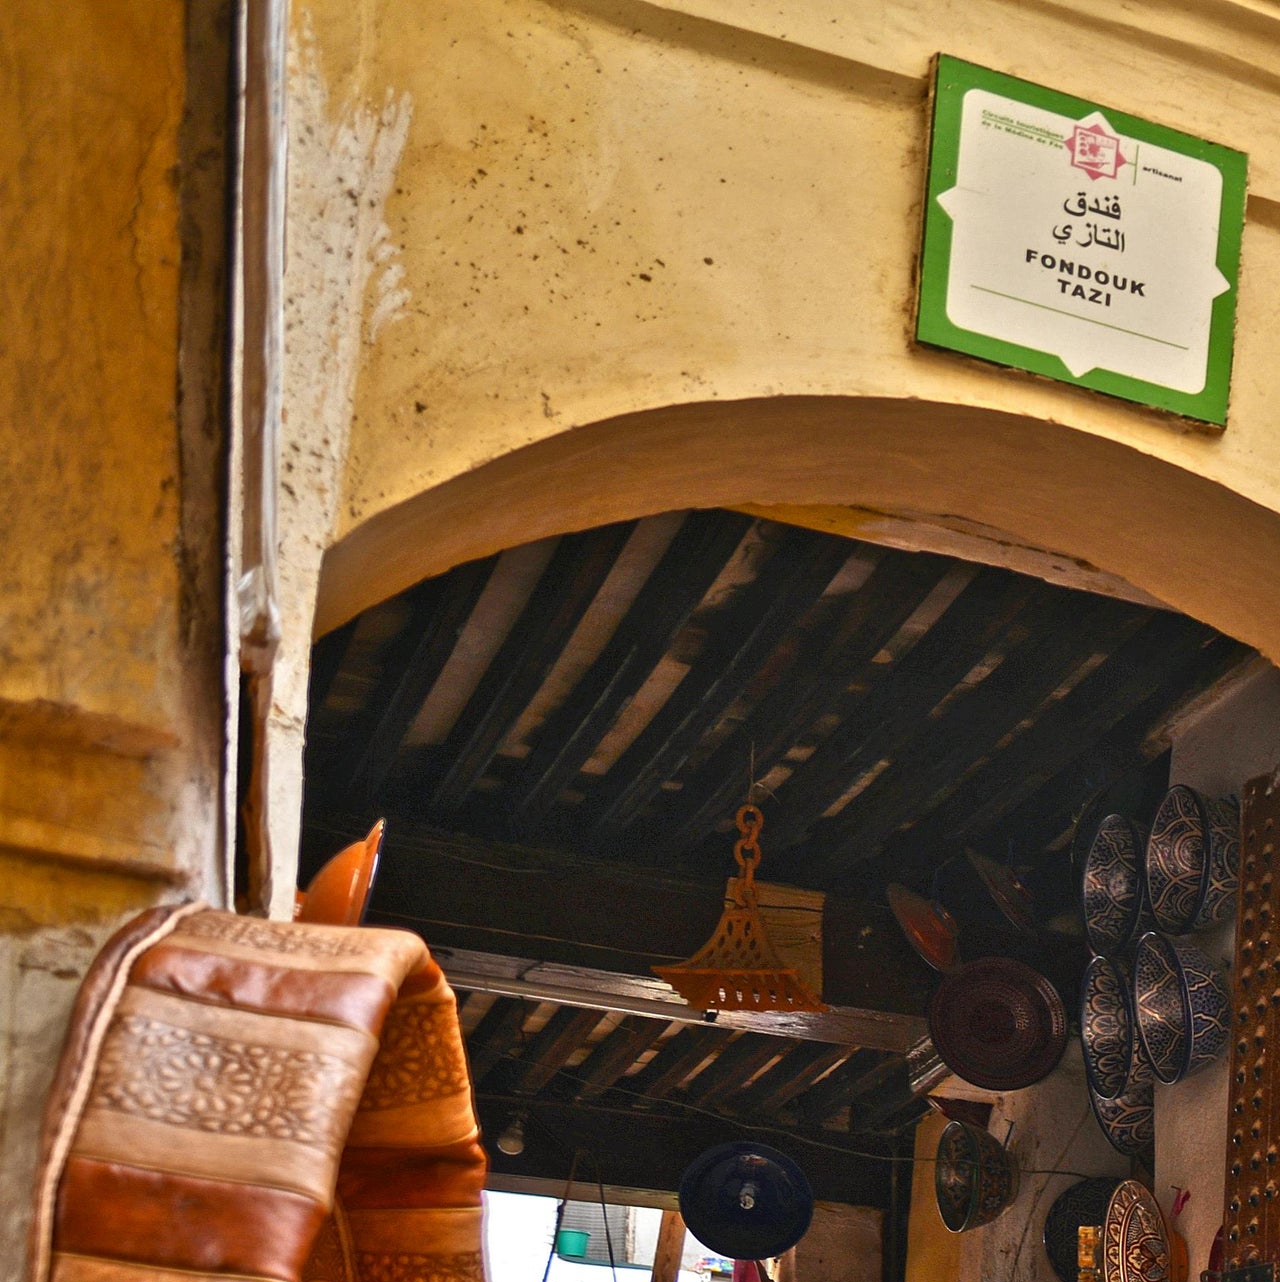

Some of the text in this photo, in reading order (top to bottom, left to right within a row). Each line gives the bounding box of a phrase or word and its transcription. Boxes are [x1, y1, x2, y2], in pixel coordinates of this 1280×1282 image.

[1063, 191, 1121, 220] فندق
[1052, 222, 1125, 253] التازي
[1025, 248, 1146, 297] FONDOUK
[1057, 278, 1111, 307] TAZI
